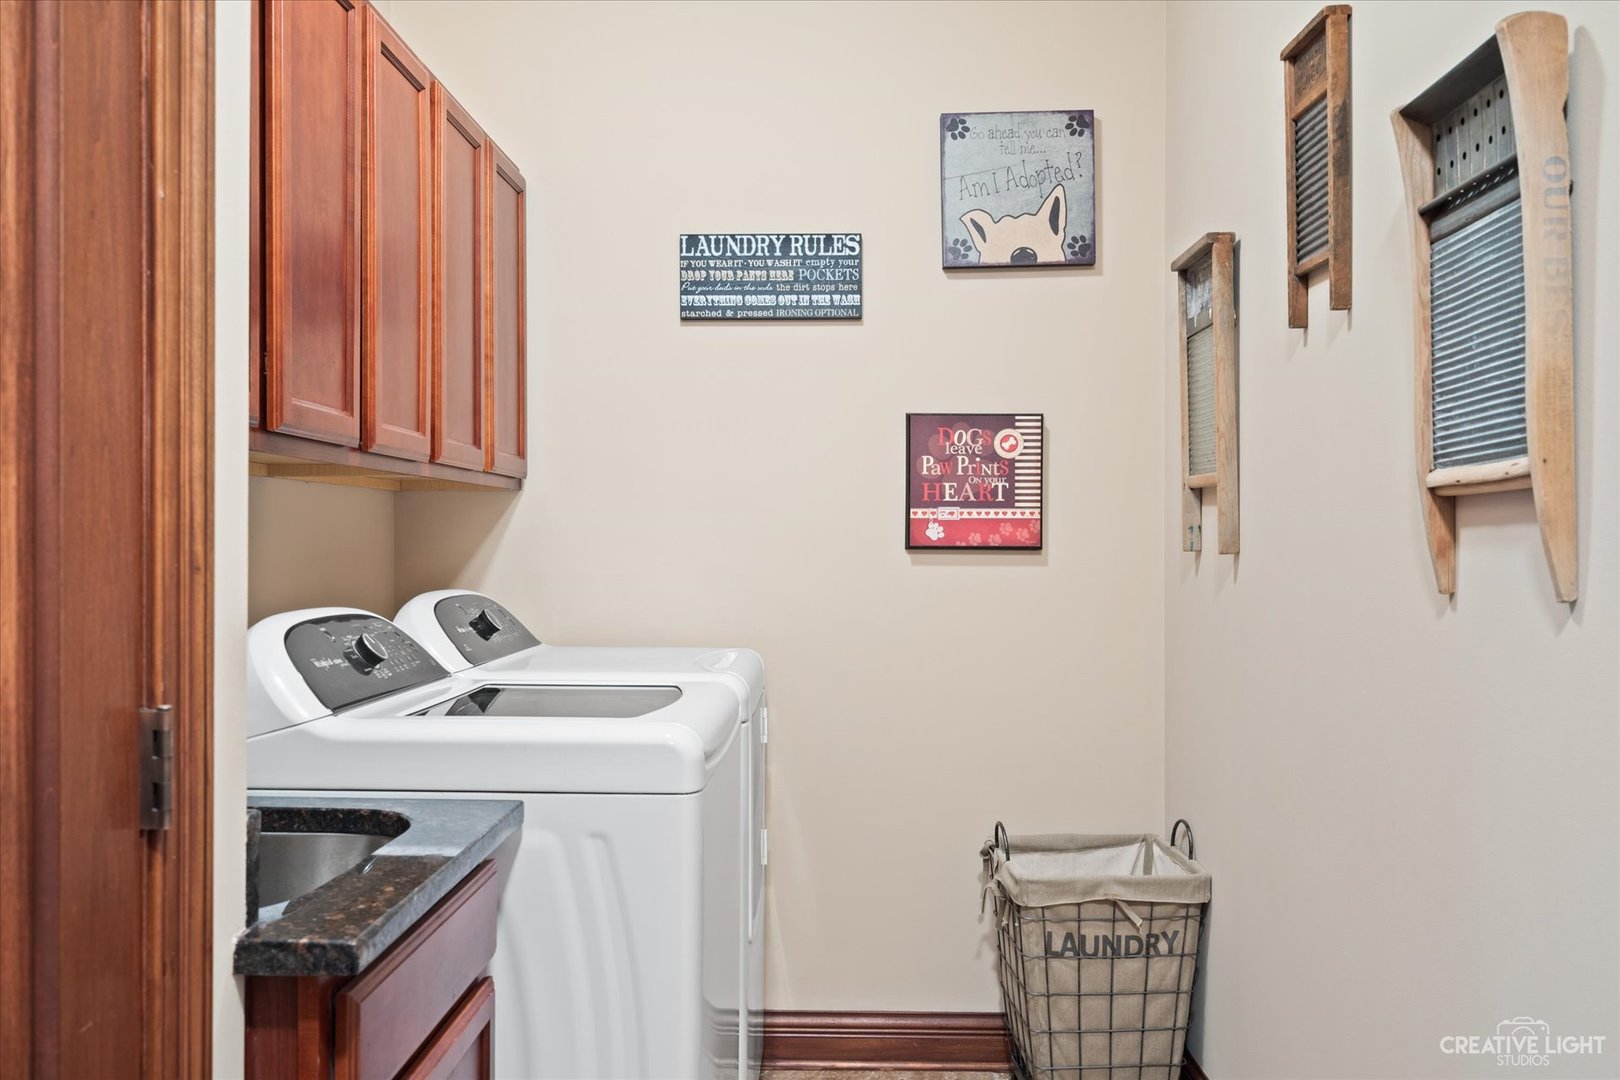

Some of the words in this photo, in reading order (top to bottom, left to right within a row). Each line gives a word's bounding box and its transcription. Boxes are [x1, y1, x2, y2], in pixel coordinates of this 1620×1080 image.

[970, 127, 985, 140] Go
[988, 123, 1020, 140] ahead
[1024, 129, 1042, 145] you
[1046, 127, 1066, 139] can
[1000, 141, 1016, 155] tell
[960, 175, 990, 200] Am
[992, 172, 1000, 194] I
[1006, 151, 1083, 199] Adopted?
[1542, 155, 1569, 242] OUR
[680, 235, 785, 256] LAUNDRY
[789, 234, 861, 256] RULES
[690, 260, 707, 268] YOU
[748, 259, 765, 267] YOU
[805, 257, 836, 268] empty
[838, 259, 859, 268] your
[680, 270, 707, 281] DROP
[708, 270, 734, 281] YOUR
[736, 270, 767, 281] PANTS
[769, 270, 794, 281] HERE
[799, 268, 860, 281] POCKETS
[776, 283, 791, 291] the
[793, 283, 810, 291] dirt
[812, 283, 835, 292] stops
[838, 283, 858, 291] here
[680, 295, 743, 306] EVERYTHING
[744, 295, 776, 306] COMES
[778, 294, 797, 306] OUT
[798, 294, 810, 306] IN
[811, 294, 831, 306] THE
[832, 294, 861, 306] WASH
[681, 310, 722, 318] starched
[736, 309, 774, 318] pressed
[776, 309, 813, 317] IRONING
[814, 309, 859, 317] OPTIONAL
[945, 442, 983, 455] leave
[921, 455, 953, 476] Paw
[984, 476, 1007, 486] your
[921, 482, 1009, 502] HEART
[1046, 930, 1180, 957] LAUNDRY
